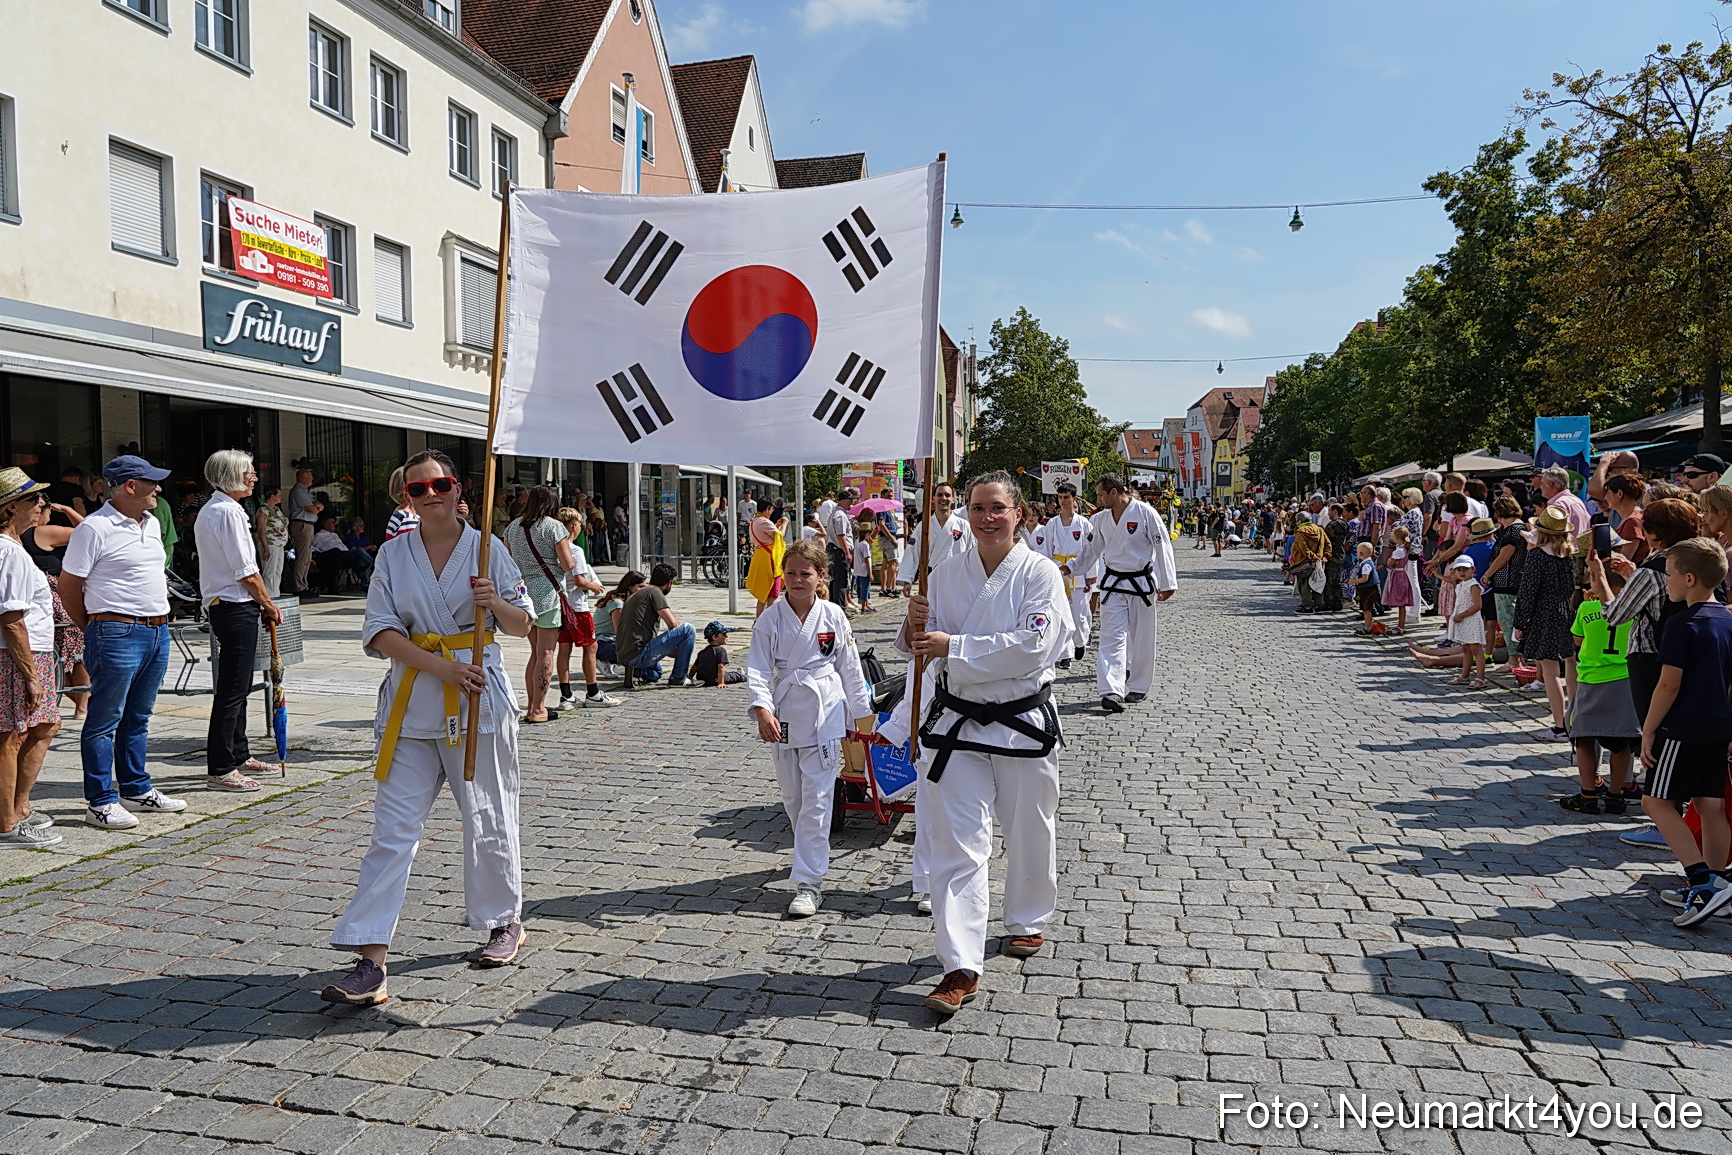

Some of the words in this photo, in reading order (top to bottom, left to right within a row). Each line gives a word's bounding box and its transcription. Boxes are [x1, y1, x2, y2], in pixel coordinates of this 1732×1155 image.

[234, 206, 280, 234] Suche
[284, 221, 324, 249] Mieter!
[276, 270, 297, 283] 09181
[302, 277, 315, 289] 509
[316, 281, 330, 293] 390
[213, 299, 339, 363] frühauf
[1193, 445, 1201, 465] SALE
[1050, 464, 1072, 474] RINGEN
[1582, 611, 1602, 624] DEU
[1602, 624, 1620, 655] 1
